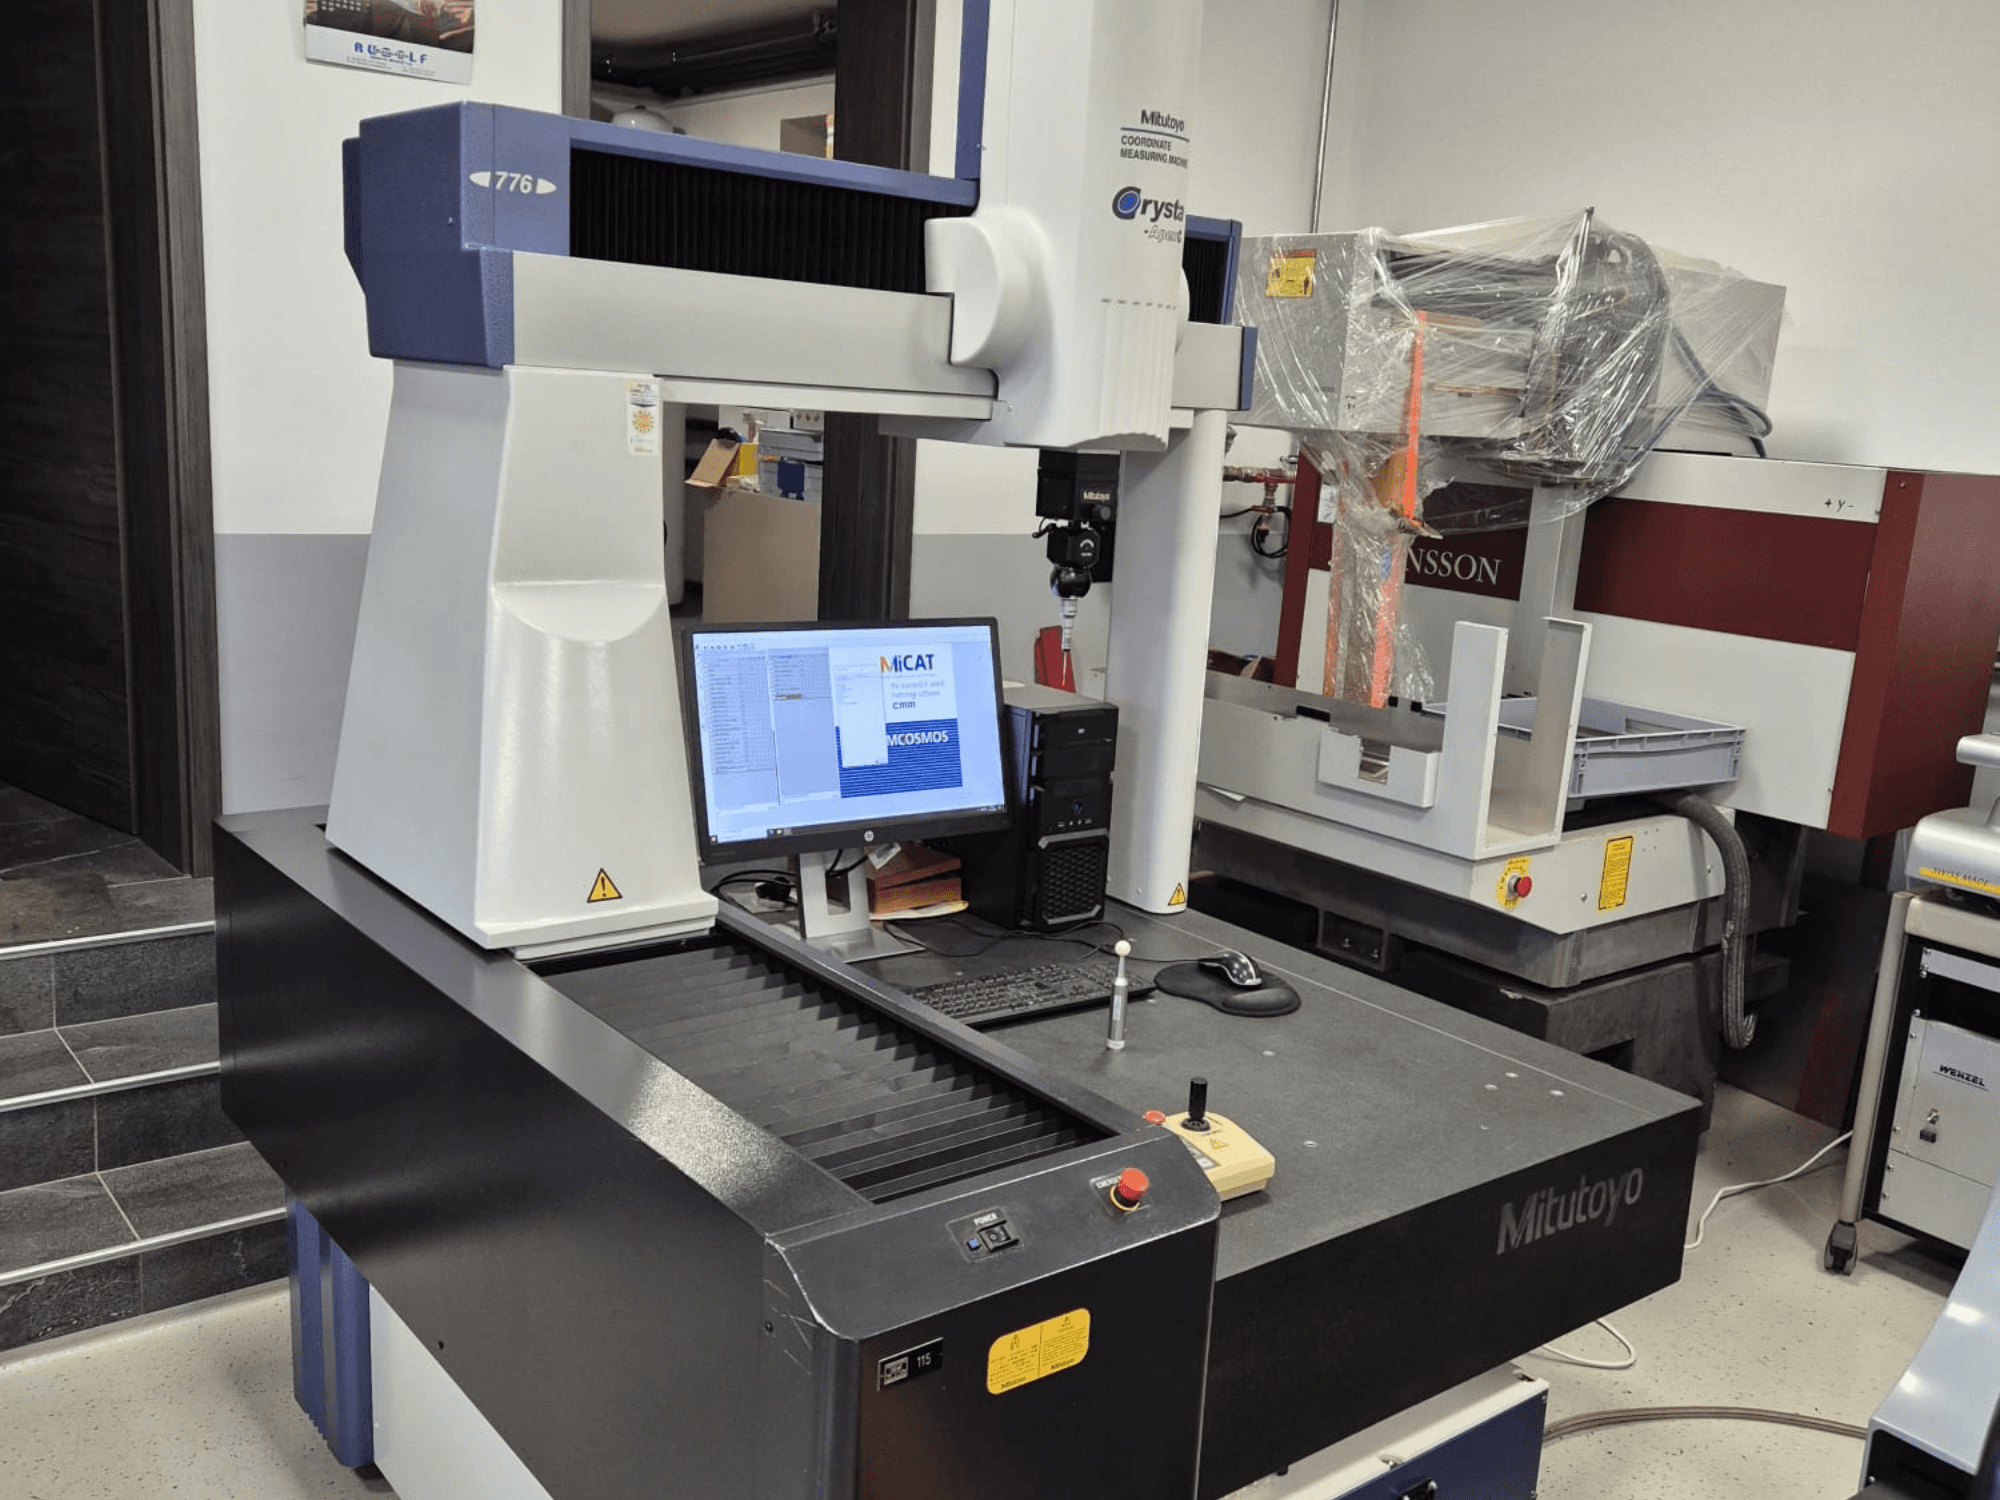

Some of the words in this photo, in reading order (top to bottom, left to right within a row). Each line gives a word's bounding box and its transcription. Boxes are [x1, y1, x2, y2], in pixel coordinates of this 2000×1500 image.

[1141, 109, 1185, 132] Mitutoyo
[1120, 135, 1172, 151] COORDINATE
[1120, 148, 1167, 163] MEASURING
[494, 171, 533, 194] 776
[879, 653, 935, 673] MiCAT
[887, 731, 949, 746] MCOSMOS
[1940, 1064, 1985, 1087] WENZEL
[1496, 1167, 1644, 1256] Mitutoyo
[916, 1352, 932, 1369] 115
